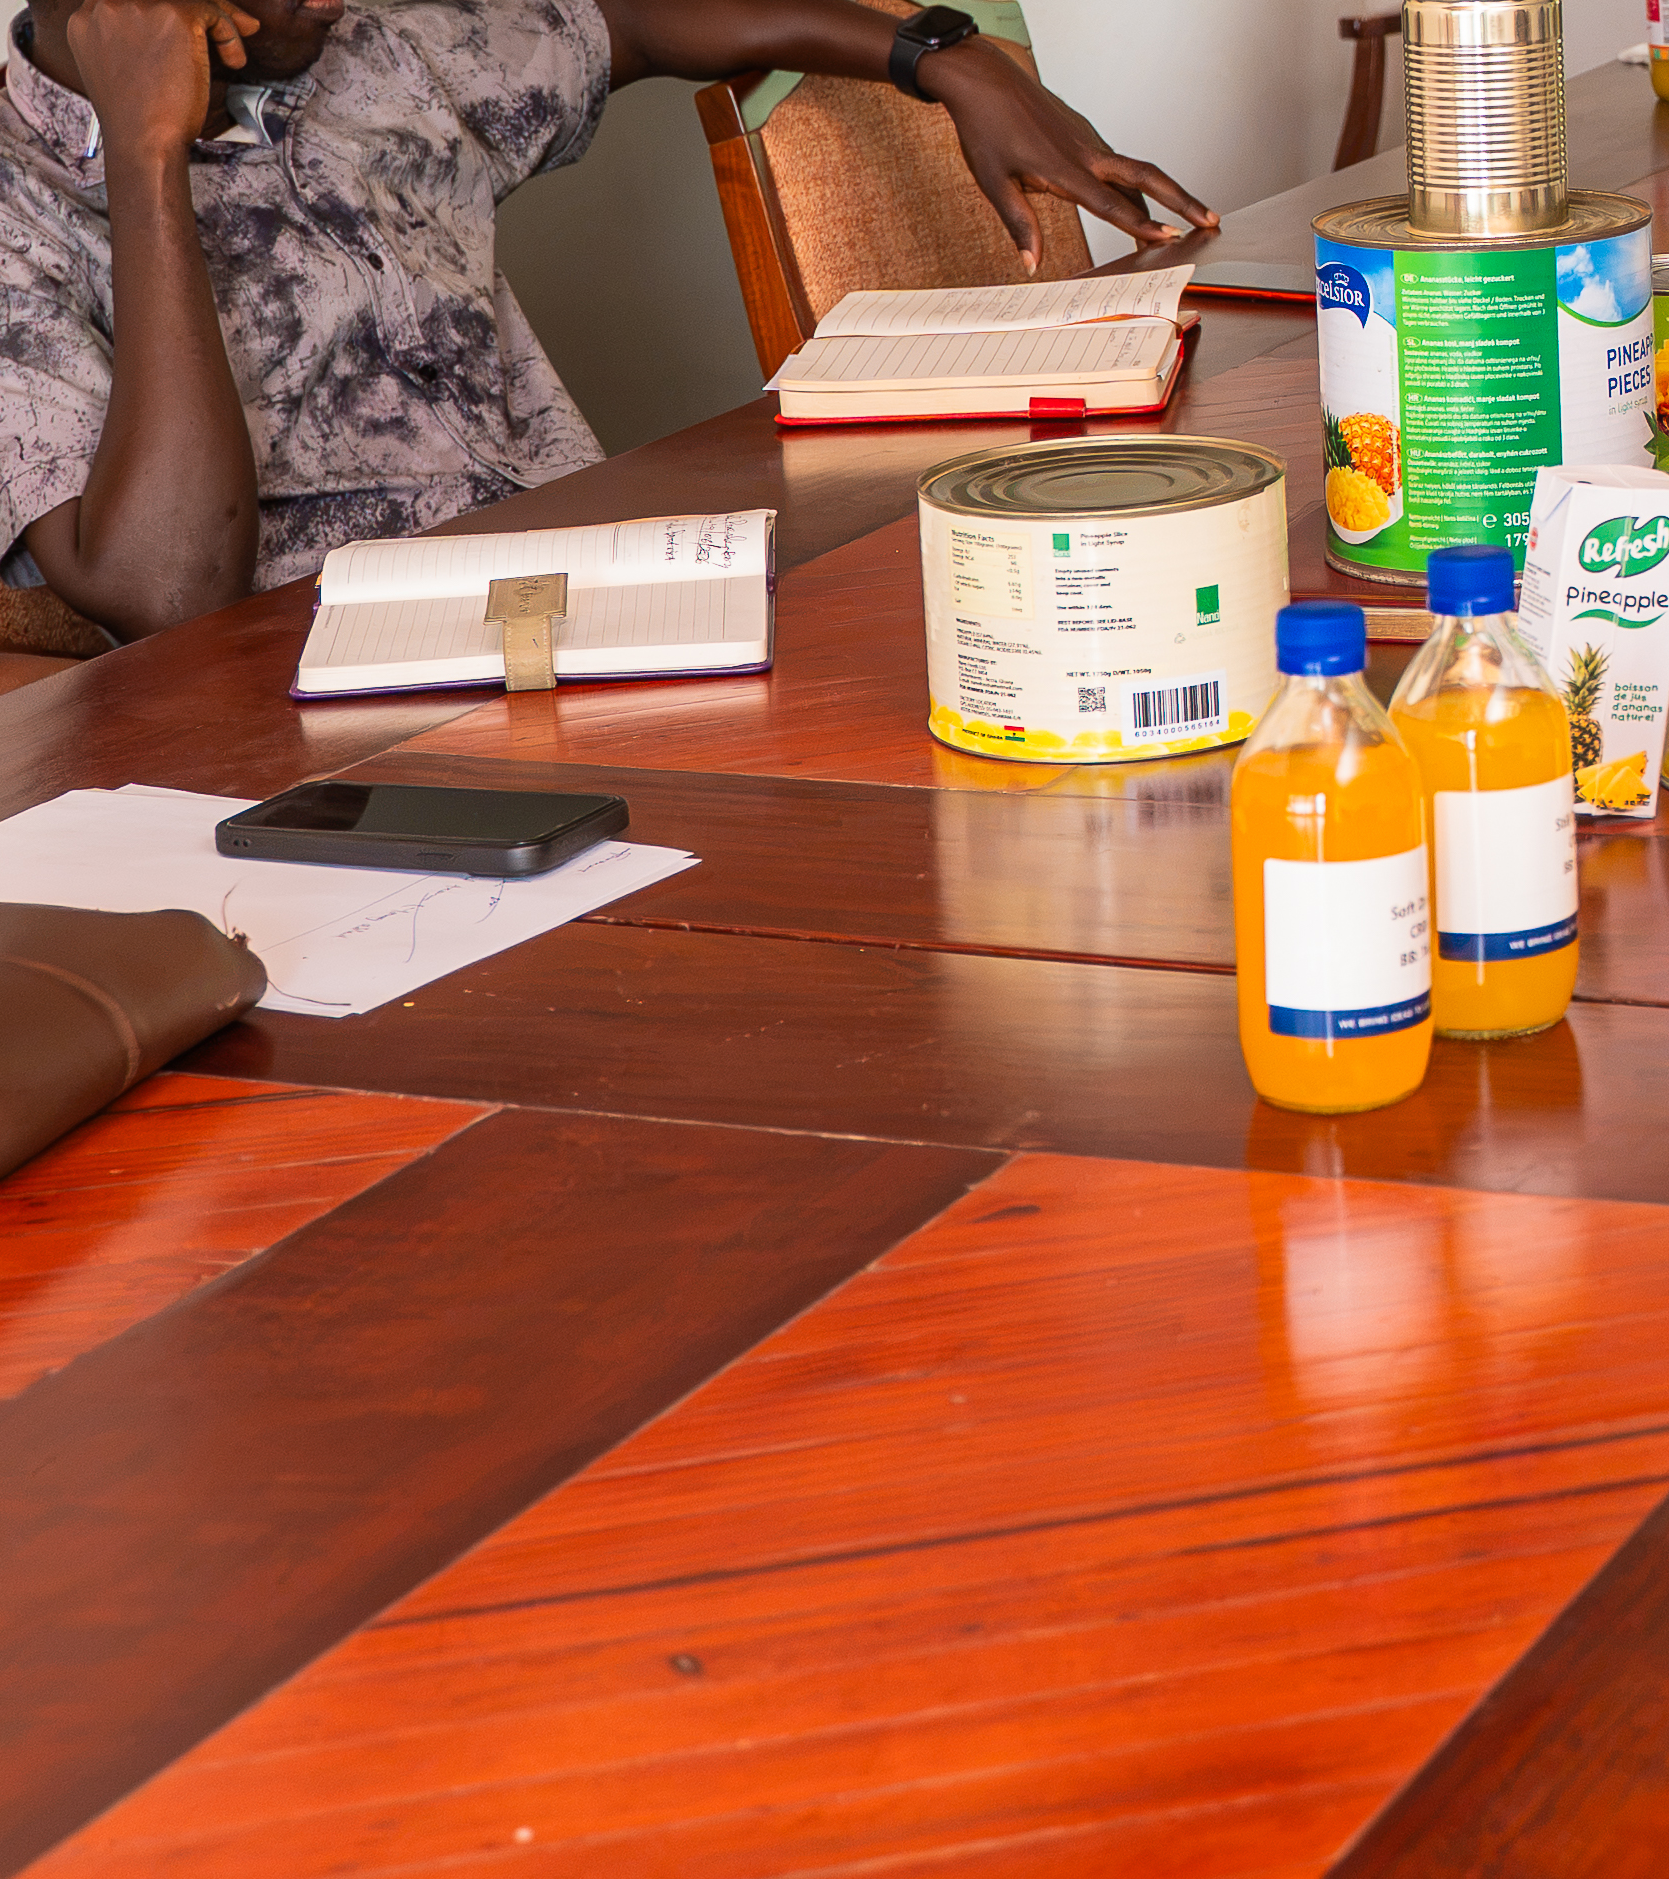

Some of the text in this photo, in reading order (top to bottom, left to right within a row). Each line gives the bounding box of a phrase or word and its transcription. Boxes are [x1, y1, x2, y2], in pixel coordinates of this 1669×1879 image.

[1608, 365, 1651, 398] PIECES
[951, 529, 995, 542] Nutrition Facts
[1566, 587, 1669, 613] Pineapple
[1615, 683, 1658, 693] boisson
[1614, 691, 1647, 703] de jus
[1613, 703, 1663, 713] d'ananas
[1611, 712, 1654, 722] naturel
